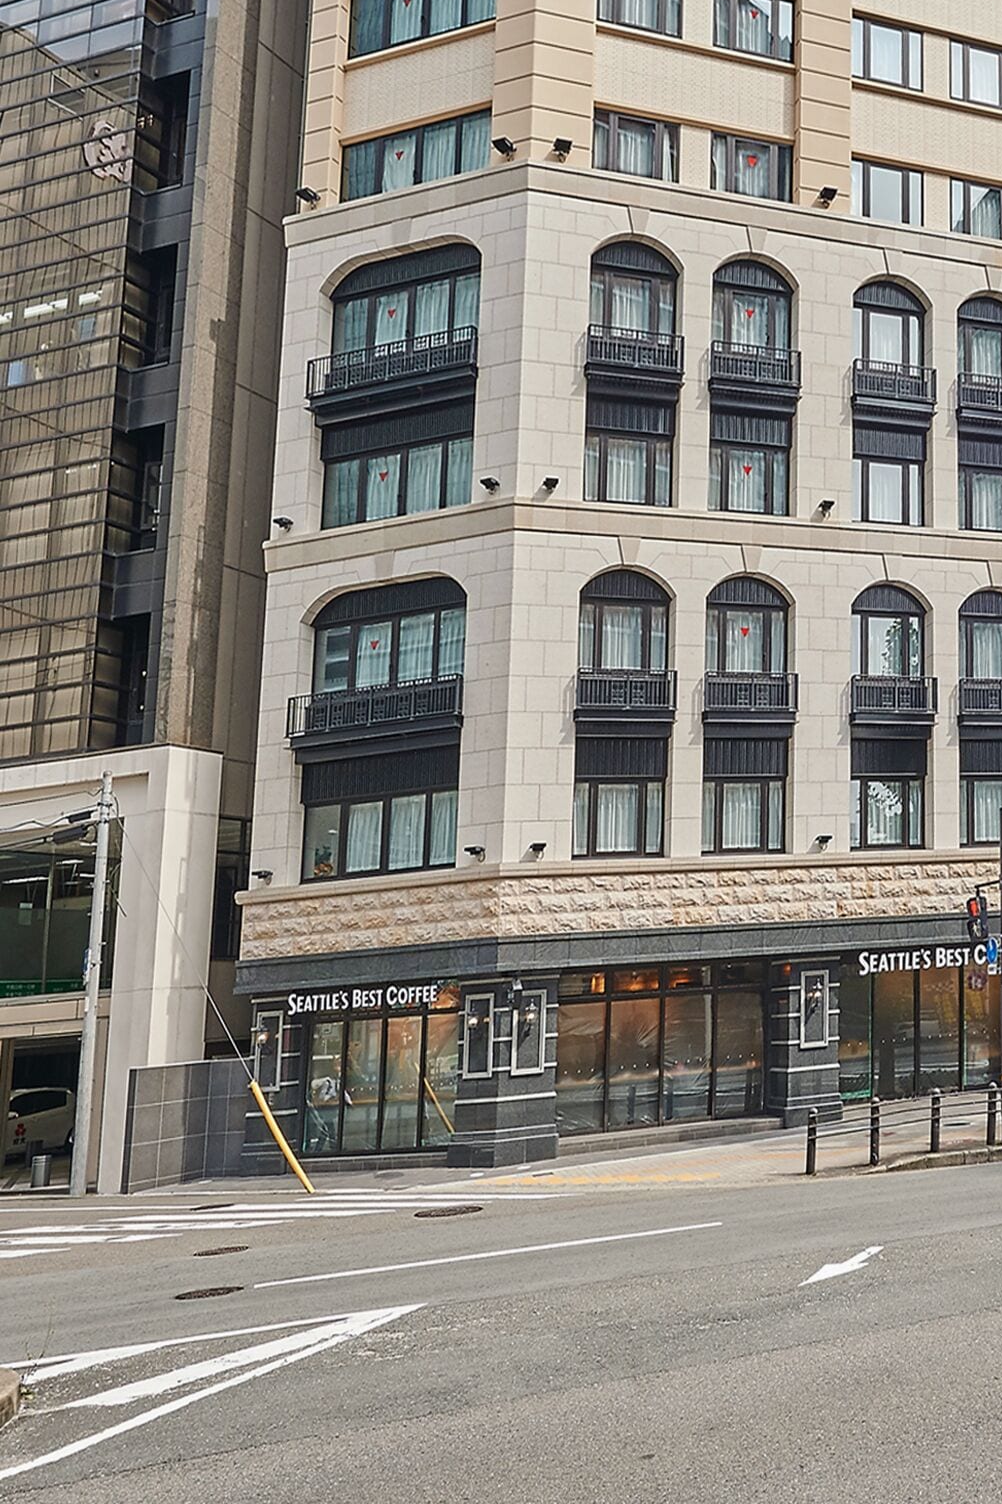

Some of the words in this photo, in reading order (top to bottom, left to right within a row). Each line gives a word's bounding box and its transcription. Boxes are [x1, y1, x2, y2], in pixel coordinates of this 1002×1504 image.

[858, 948, 931, 976] SEATTLE'S
[936, 947, 970, 968] BEST
[288, 991, 349, 1016] SEATTLE'S
[352, 989, 384, 1009] BEST
[386, 985, 438, 1006] COFFEE
